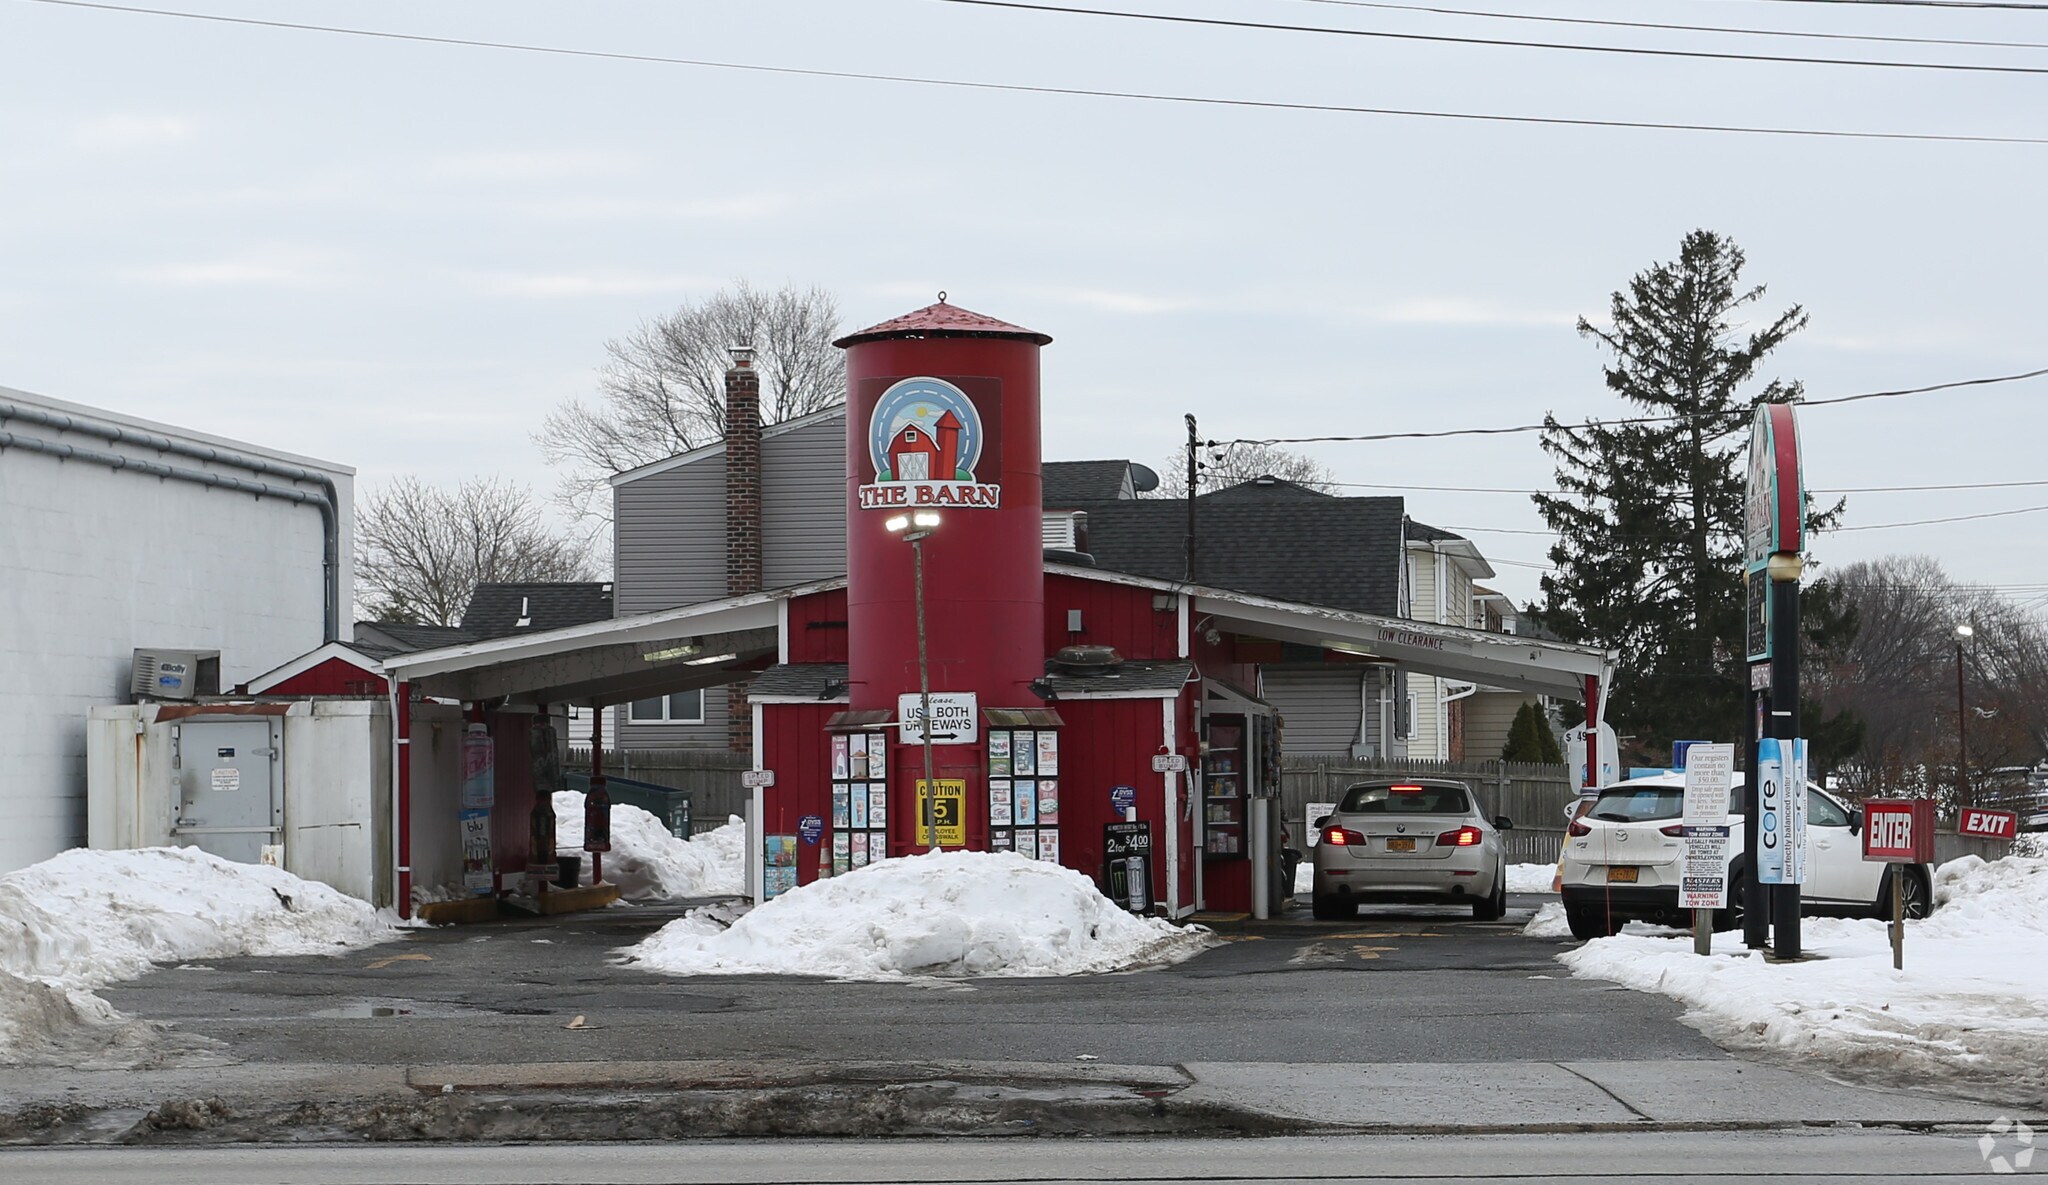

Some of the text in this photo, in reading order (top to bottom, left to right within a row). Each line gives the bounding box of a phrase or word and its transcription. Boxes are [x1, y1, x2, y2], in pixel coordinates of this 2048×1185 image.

[860, 484, 998, 506] THE BARN
[1377, 629, 1444, 650] LOW CLEARANCE
[907, 706, 969, 719] US BOTH
[905, 719, 972, 731] DREWAYS
[1704, 754, 1730, 764] registers
[920, 785, 961, 796] CUTION
[933, 799, 948, 818] 5
[1763, 779, 1778, 849] core
[467, 822, 484, 832] blu
[1869, 812, 1913, 849] ENTER
[1966, 812, 2010, 835] EXIT
[1784, 837, 1793, 878] perfectly
